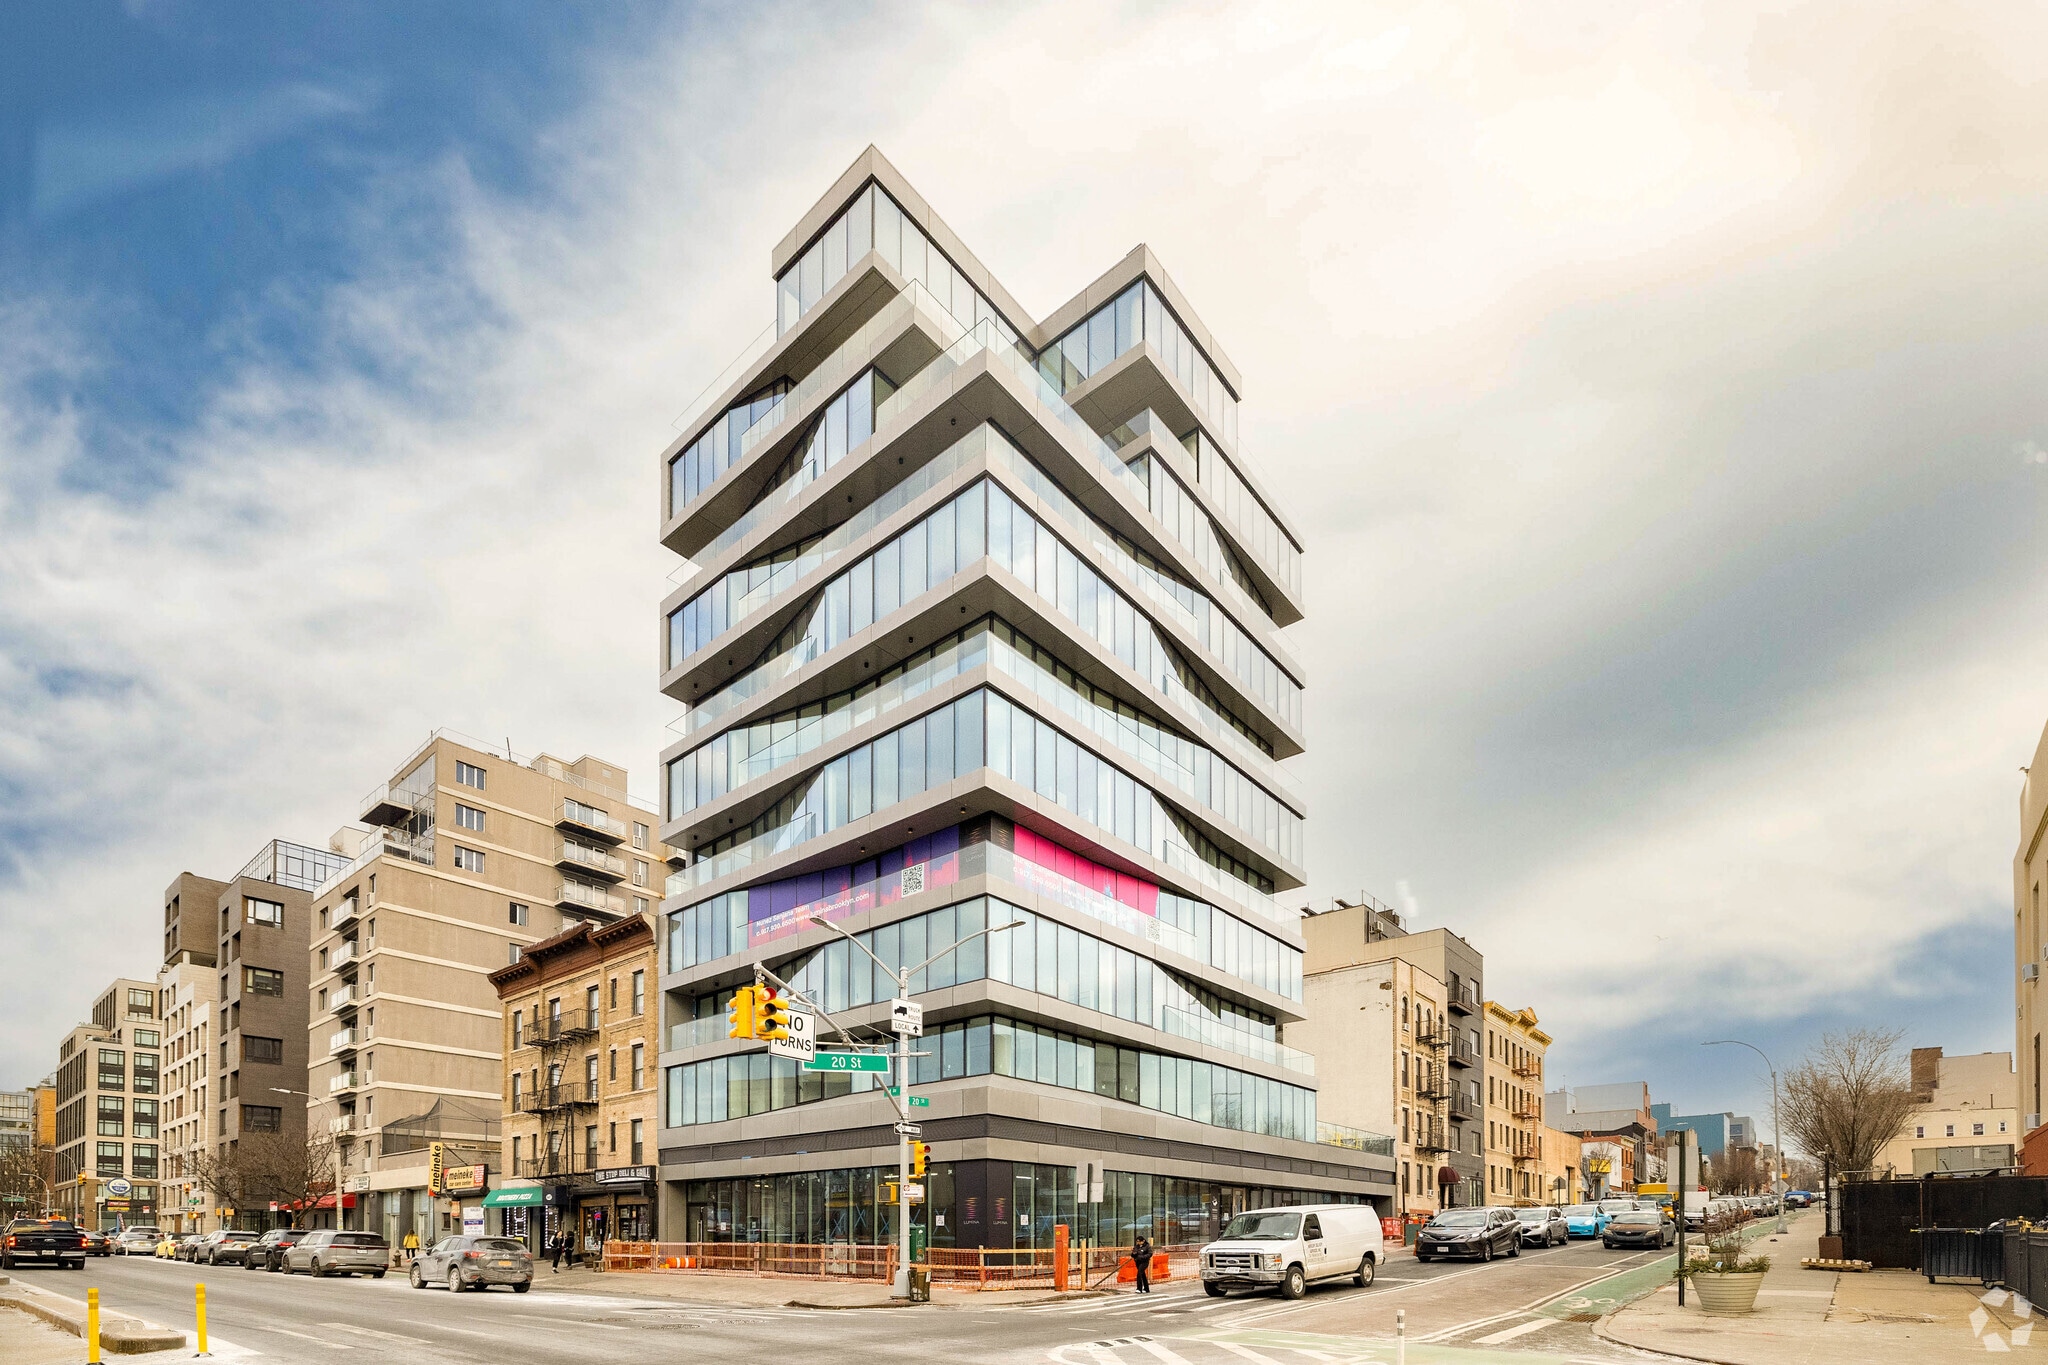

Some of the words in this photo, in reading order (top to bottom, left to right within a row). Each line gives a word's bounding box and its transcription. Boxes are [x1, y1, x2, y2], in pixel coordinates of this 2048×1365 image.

[894, 1022, 911, 1031] LOCAL
[831, 1056, 846, 1068] 20
[850, 1057, 862, 1069] St
[912, 1097, 920, 1105] 20
[432, 1145, 442, 1188] meineke
[449, 1169, 474, 1181] meineke
[605, 1170, 618, 1179] STOP
[618, 1169, 630, 1177] DELI
[635, 1167, 651, 1178] GRILL
